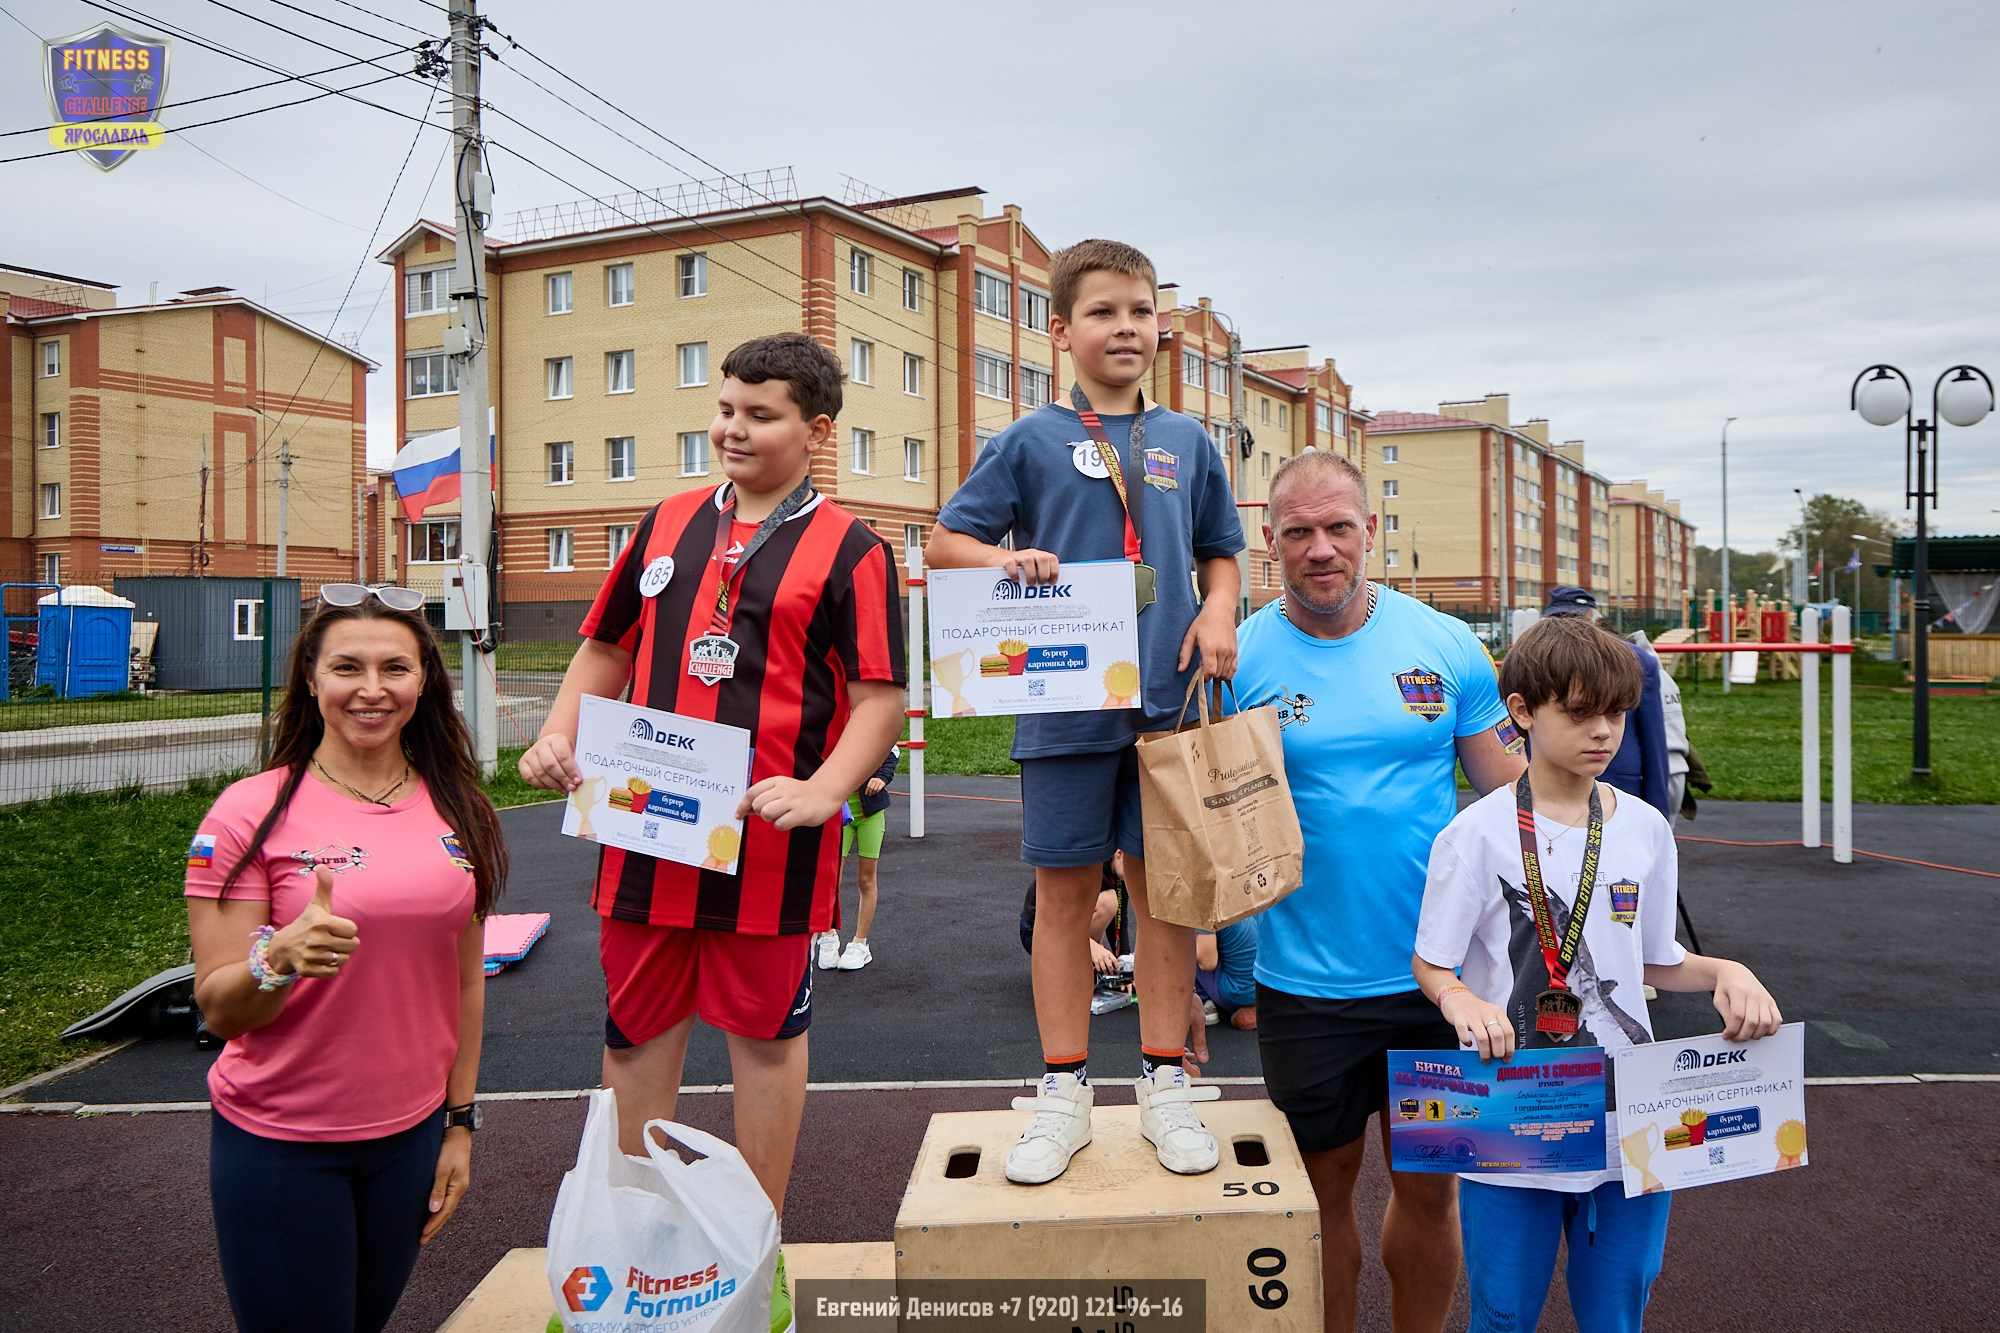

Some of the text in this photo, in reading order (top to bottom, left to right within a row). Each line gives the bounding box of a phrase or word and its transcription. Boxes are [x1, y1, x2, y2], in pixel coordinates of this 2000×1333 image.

[1148, 452, 1174, 464] FITNESS
[645, 565, 672, 587] 185
[942, 620, 1125, 639] ПОДАРОЧНЫЙ СЕРТИФИКАТ
[1042, 649, 1069, 659] бургер
[691, 662, 732, 676] CHALLENGE
[1028, 659, 1084, 670] картошка фри
[1400, 675, 1436, 684] FITNESS
[584, 752, 661, 779] ПОДАРОЧНЫЙ
[664, 770, 735, 796] СЕРТИФИКАТ
[1210, 794, 1238, 806] SAVE
[1244, 779, 1269, 794] PLANET
[661, 795, 684, 808] бургер
[648, 803, 695, 820] картошка фри
[1591, 822, 1602, 830] 17
[1612, 885, 1638, 894] FITNESS
[1529, 852, 1556, 950] ПО ФИТНЕС-ЧЕЛЛЕНДЖУ
[1560, 850, 1598, 963] БИТВА НА СТРЕЛКЕ
[1538, 1019, 1576, 1034] CHALLENGE
[1414, 1061, 1462, 1077] БИТВА
[1497, 1066, 1540, 1082] ДИПЛОМ
[1552, 1062, 1602, 1078] СТЕПЕНИ
[1628, 1090, 1714, 1116] ПОДАРОЧНЫЙ
[1717, 1080, 1794, 1101] СЕРТИФИКАТ
[1719, 1113, 1744, 1124] бургер
[1706, 1121, 1757, 1138] картошка фри
[1222, 1182, 1280, 1197] 50
[626, 1262, 718, 1295] Fitness
[1246, 1248, 1288, 1310] 60
[572, 1302, 724, 1333] ФОРМУЛА ТВОЕГО УСПЕХА
